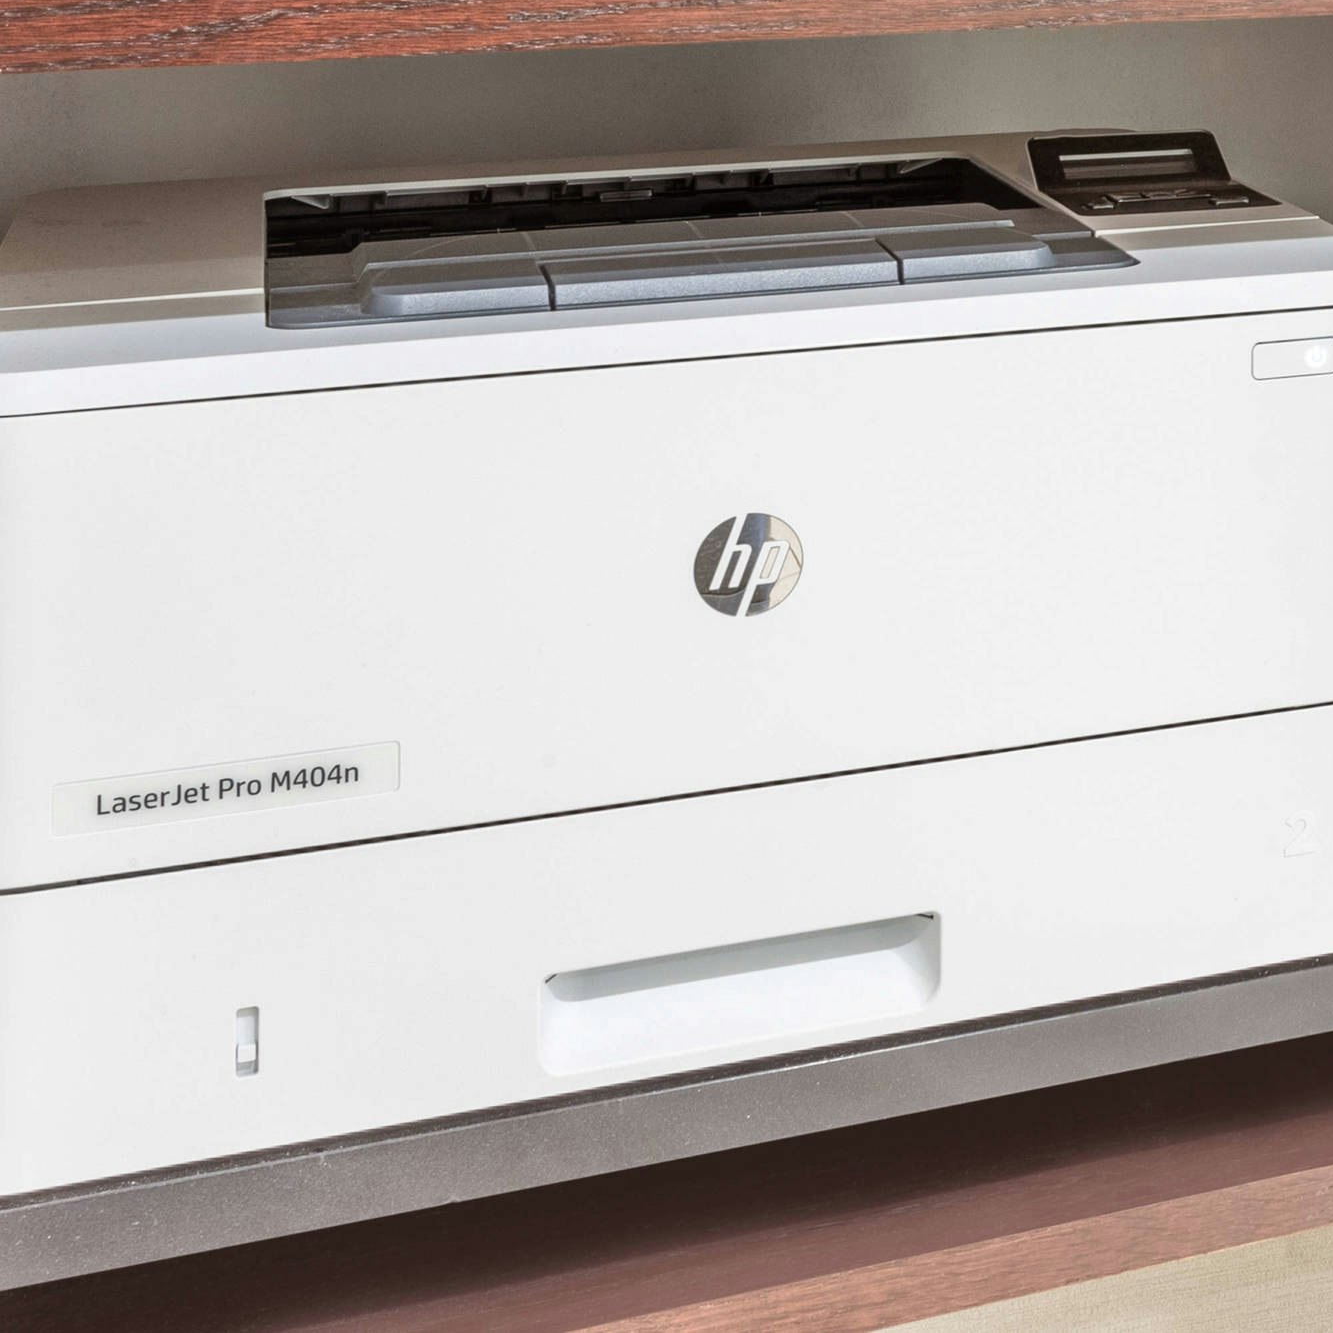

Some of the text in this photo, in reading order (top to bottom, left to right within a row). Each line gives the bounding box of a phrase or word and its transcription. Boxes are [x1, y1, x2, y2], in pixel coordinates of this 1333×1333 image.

[703, 512, 797, 617] hp
[96, 763, 360, 816] LaserJet Pro M404n
